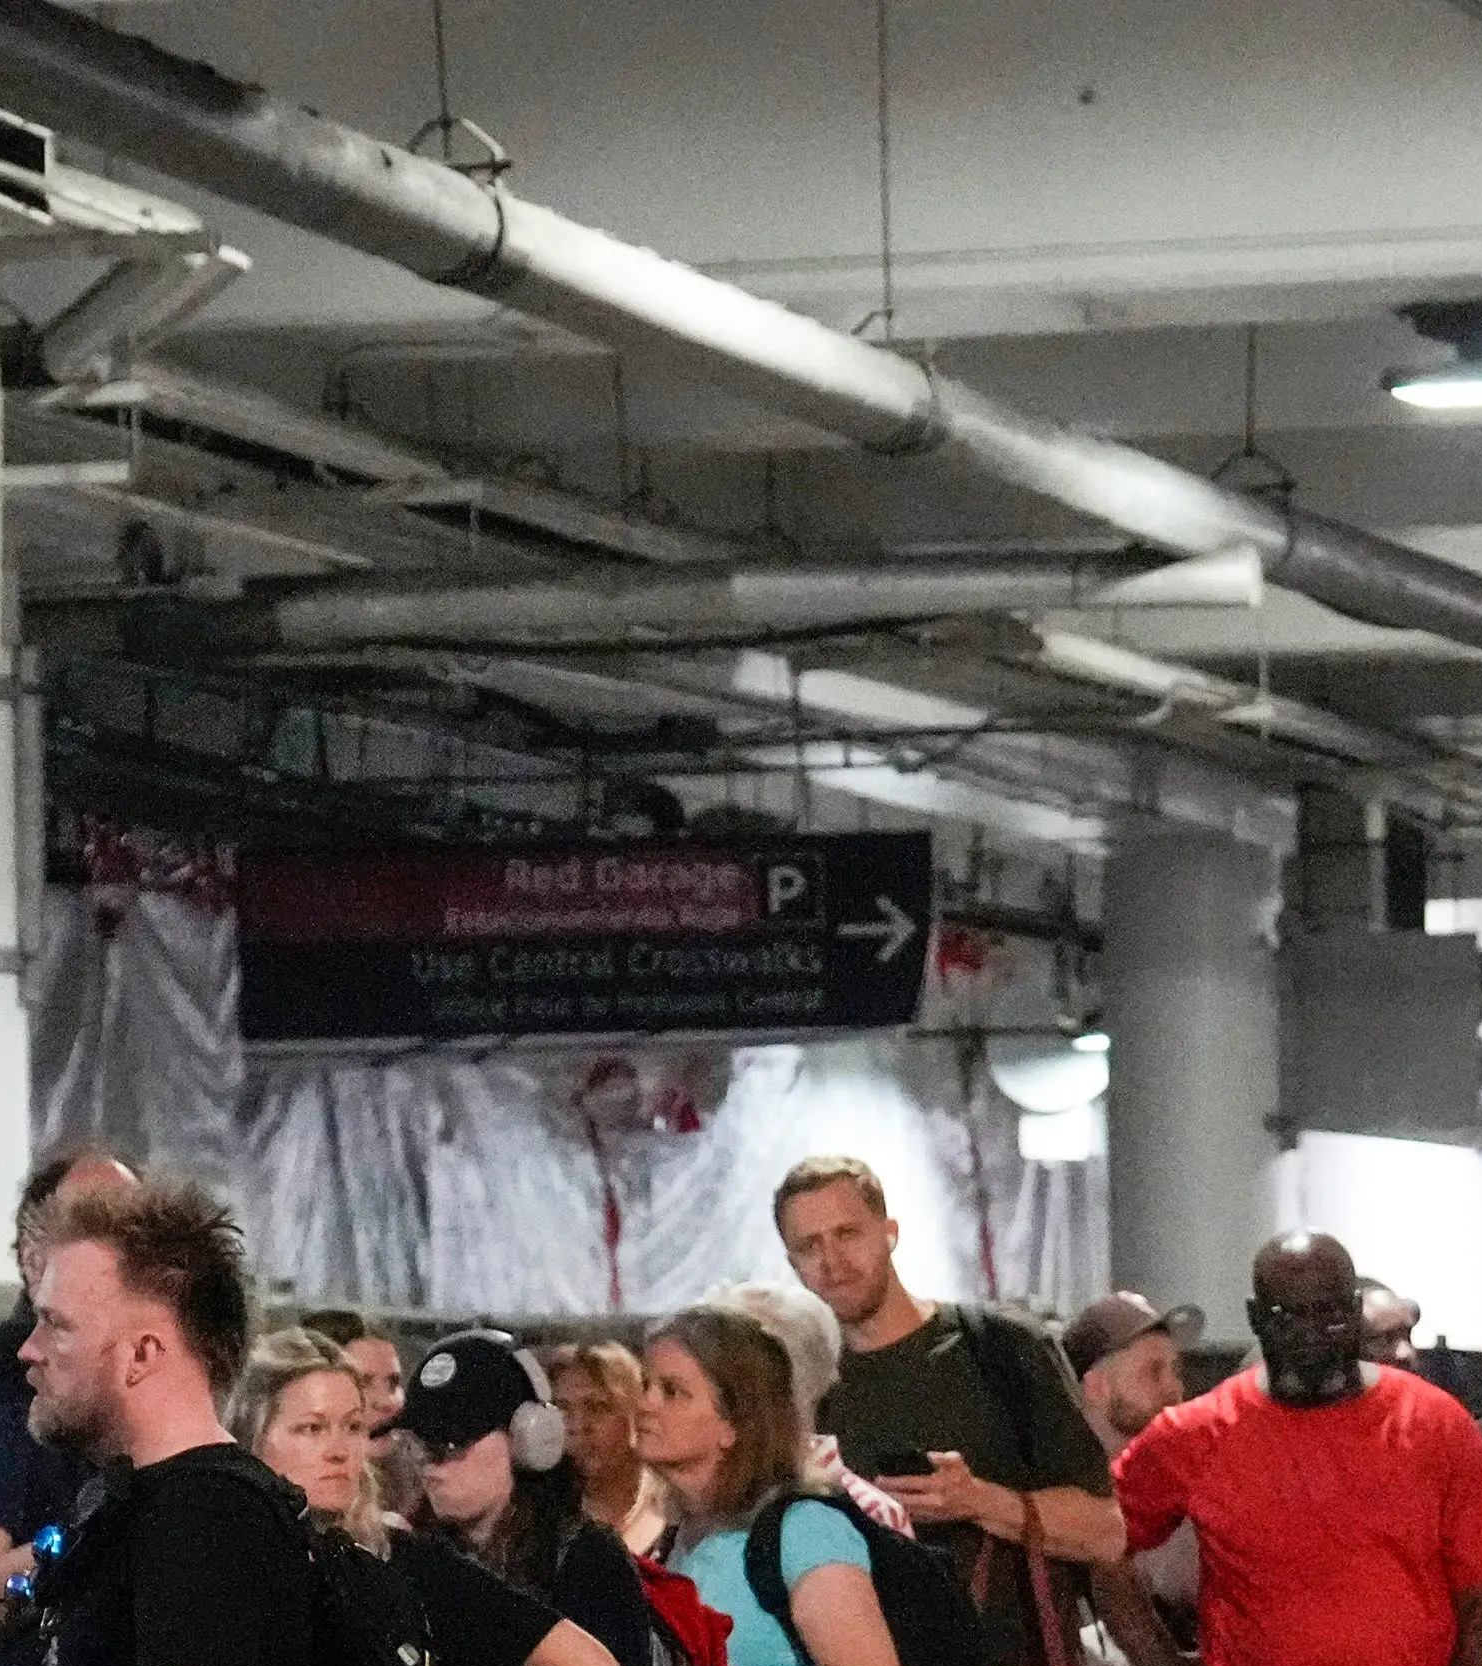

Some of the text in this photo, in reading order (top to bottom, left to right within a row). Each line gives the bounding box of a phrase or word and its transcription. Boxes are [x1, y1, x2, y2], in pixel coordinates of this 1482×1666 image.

[504, 857, 742, 900] Red Garage
[767, 865, 808, 913] P
[487, 944, 615, 980] Central
